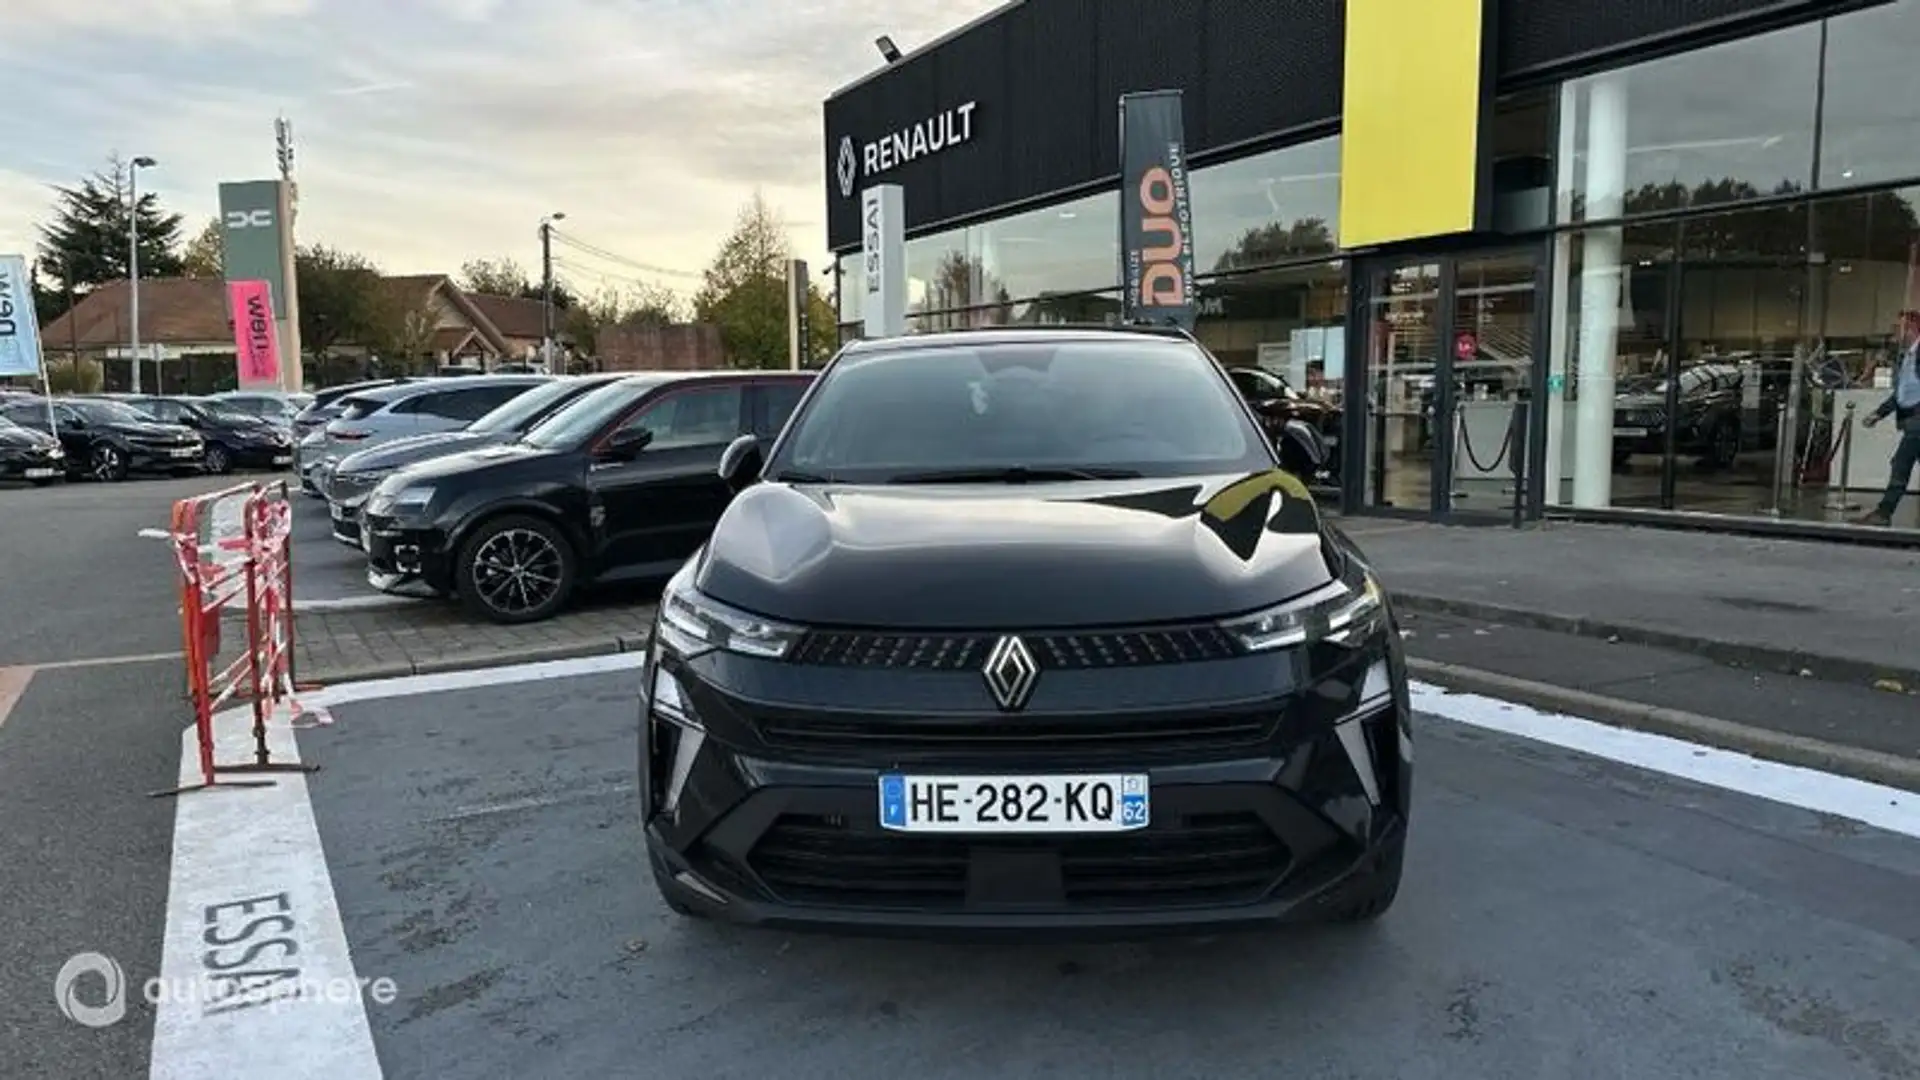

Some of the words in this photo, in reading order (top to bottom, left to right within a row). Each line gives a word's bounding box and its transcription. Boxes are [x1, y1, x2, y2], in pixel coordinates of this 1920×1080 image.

[864, 101, 976, 176] RENAULT
[867, 199, 880, 294] ESSAI
[1140, 167, 1184, 306] DUO
[911, 782, 1113, 822] HE-282-KQ
[1123, 802, 1145, 821] 62
